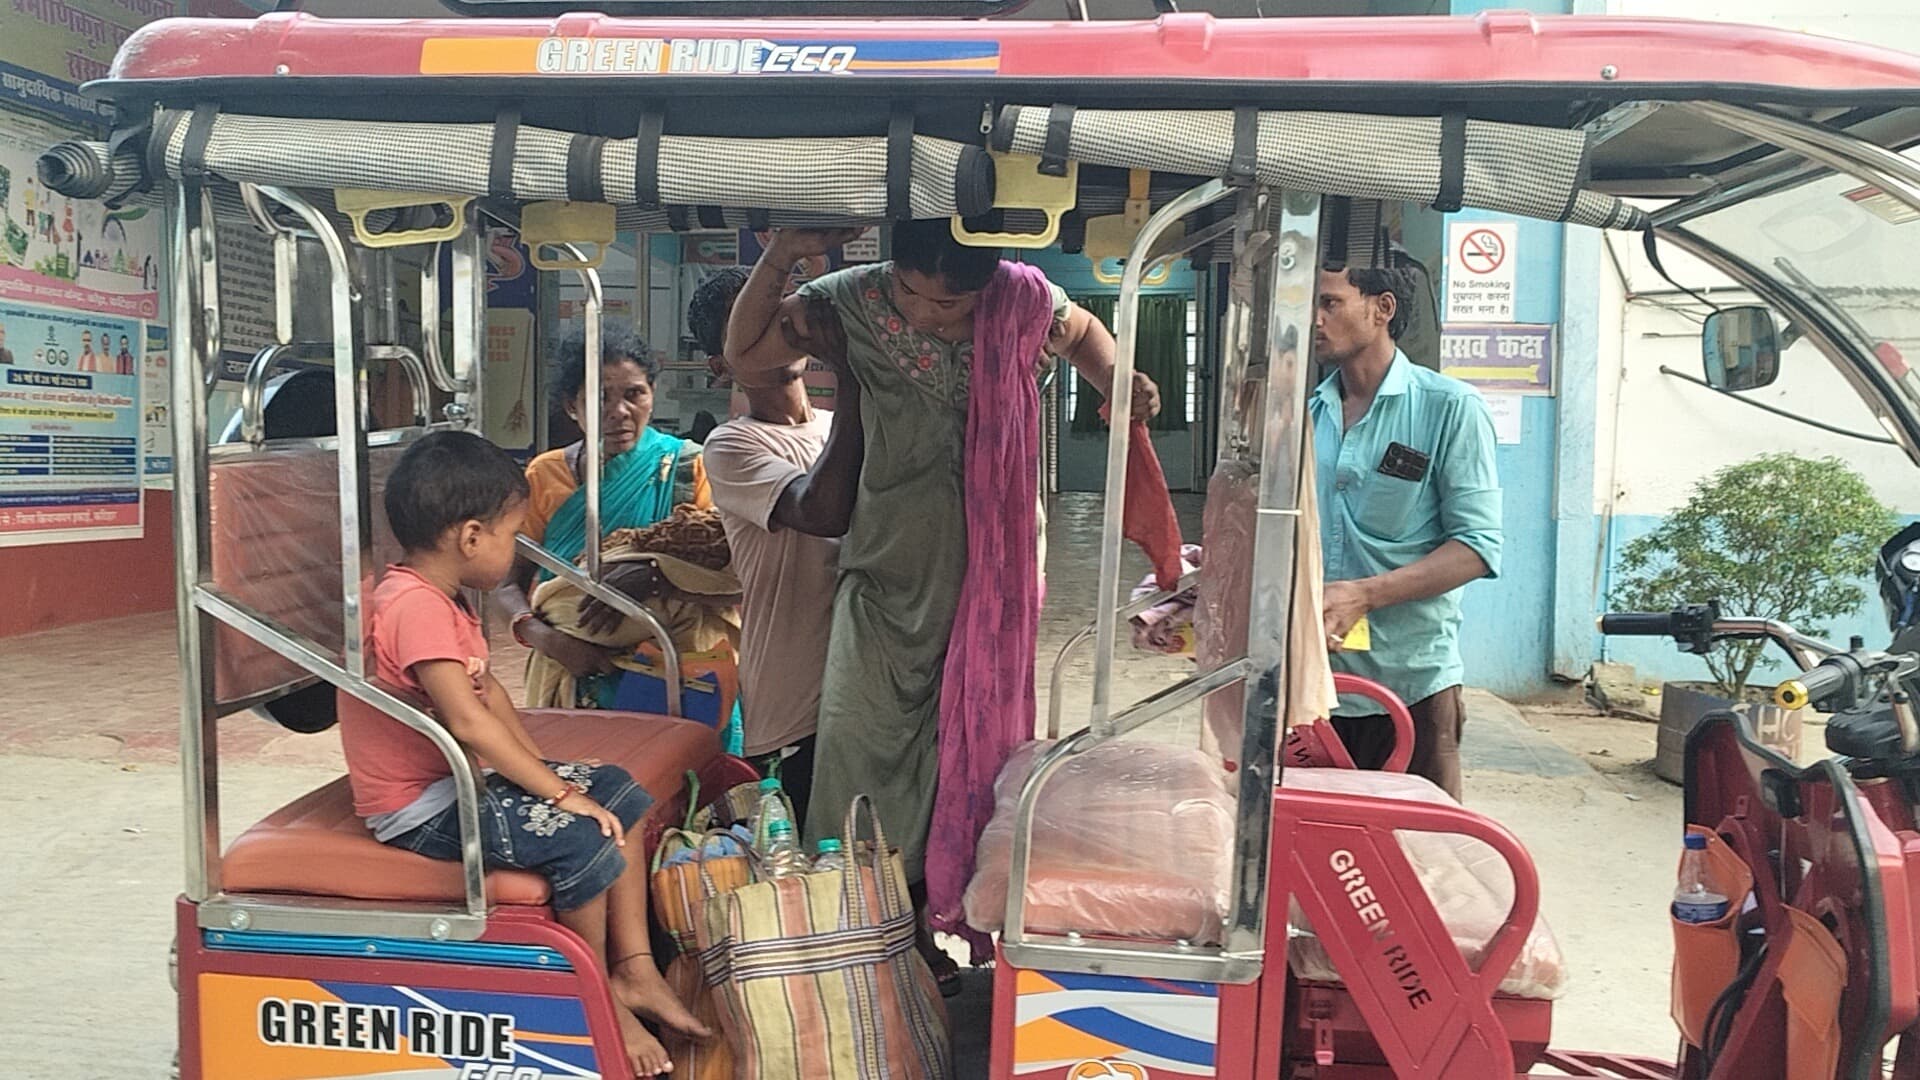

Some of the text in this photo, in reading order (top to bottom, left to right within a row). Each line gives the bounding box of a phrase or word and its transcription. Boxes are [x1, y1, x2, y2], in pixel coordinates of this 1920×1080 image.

[537, 38, 857, 75] GREEN RIDE ECO
[1453, 279, 1511, 290] No Smoking
[1478, 304, 1495, 314] मना
[1486, 292, 1511, 302] करना
[1495, 335, 1546, 359] कक्ष
[1329, 848, 1433, 1011] GREEN RIDE
[259, 999, 515, 1062] GREEN RIDE
